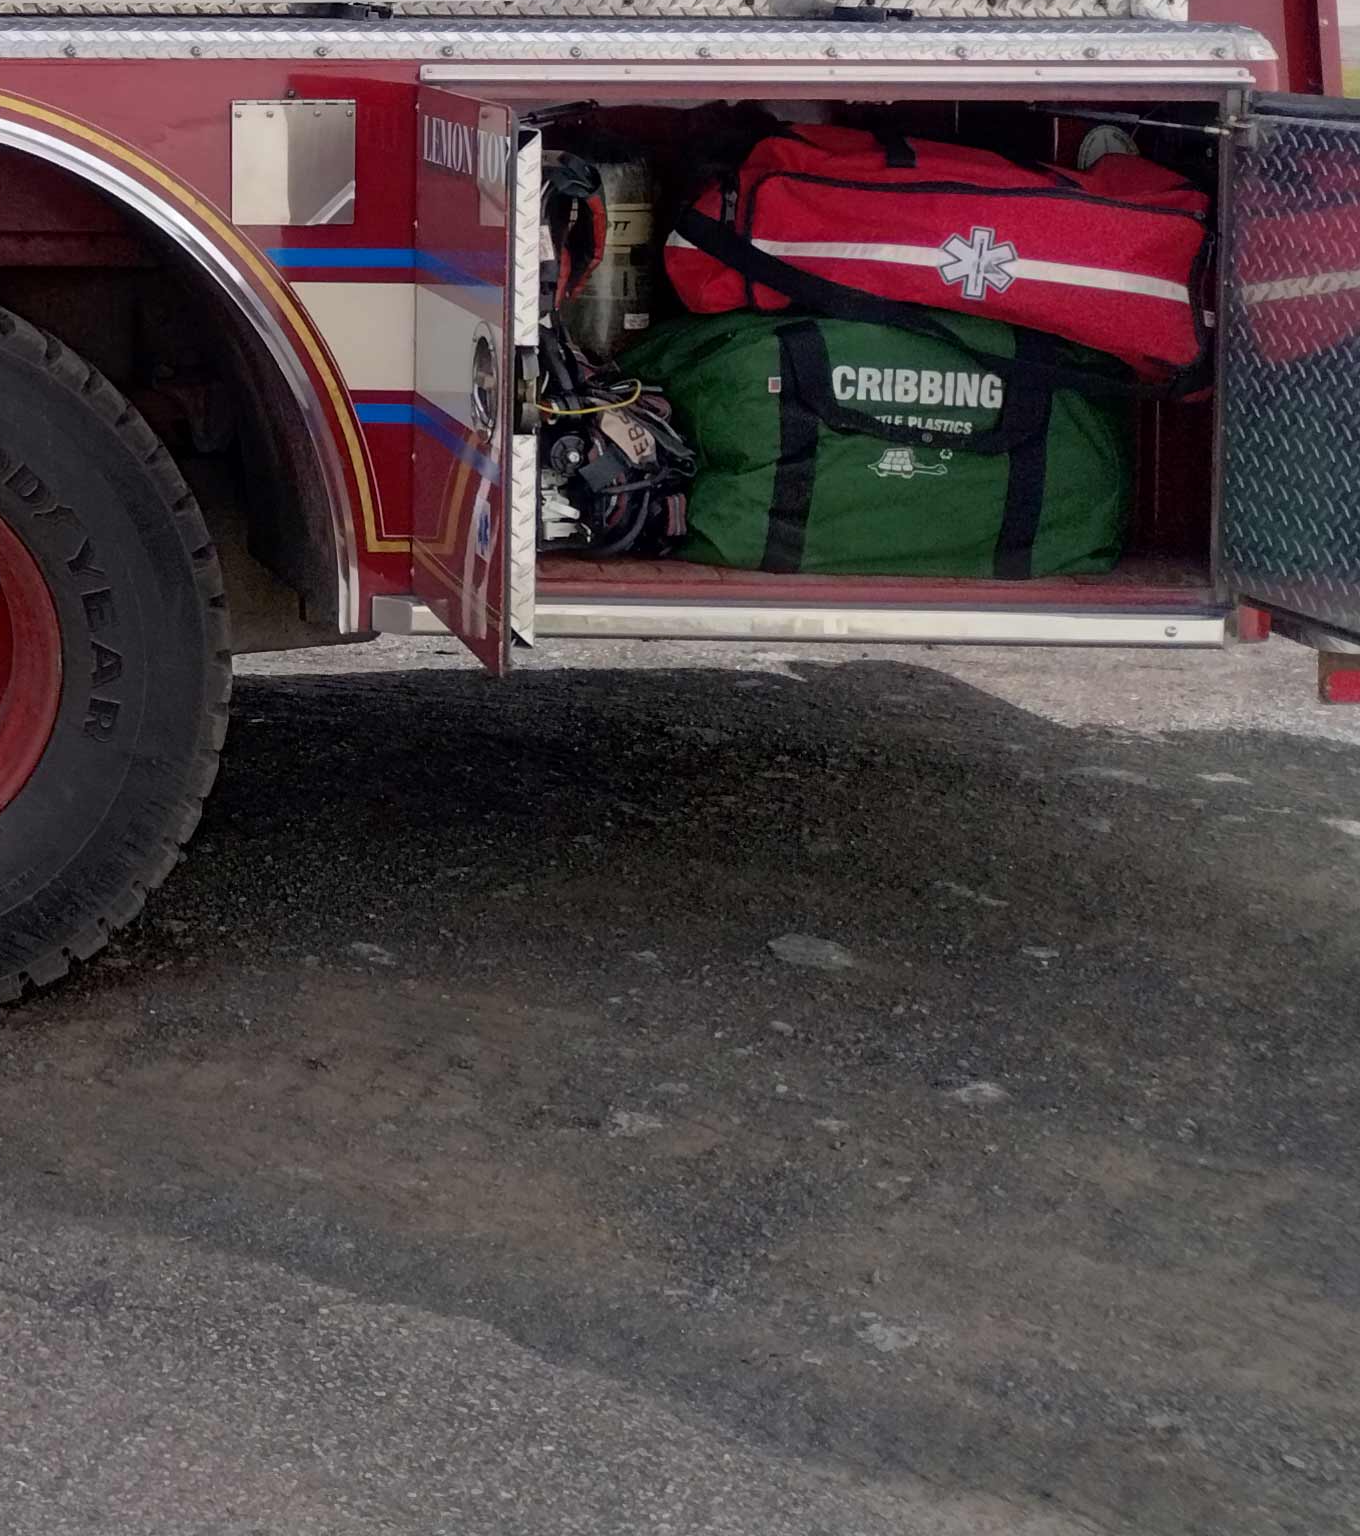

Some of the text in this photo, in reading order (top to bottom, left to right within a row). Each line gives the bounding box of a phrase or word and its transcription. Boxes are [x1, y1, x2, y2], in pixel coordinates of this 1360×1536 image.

[423, 115, 474, 175] LEMON
[832, 365, 1003, 409] CRIBBING
[908, 416, 973, 435] PLASTICS
